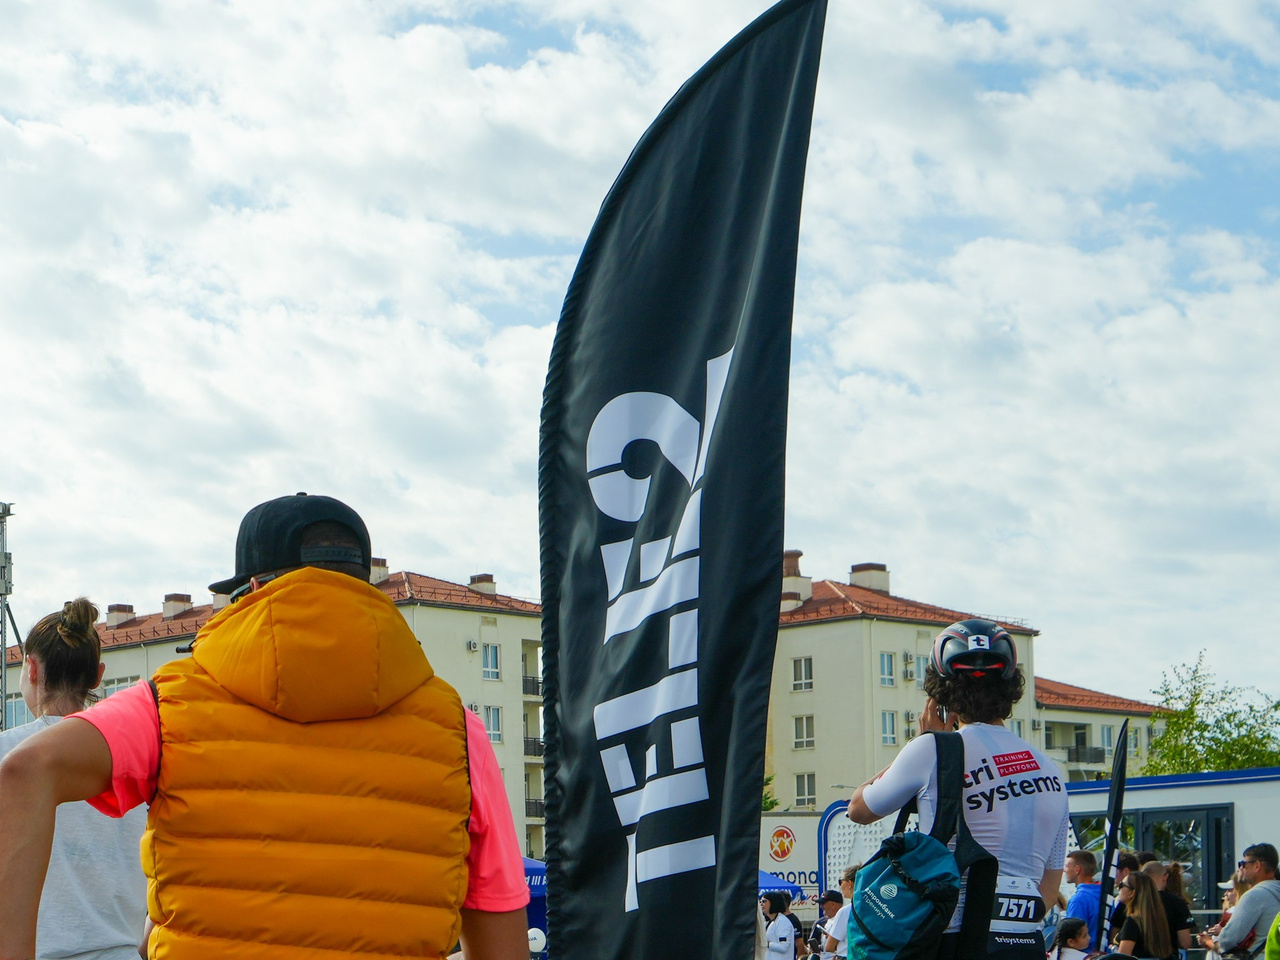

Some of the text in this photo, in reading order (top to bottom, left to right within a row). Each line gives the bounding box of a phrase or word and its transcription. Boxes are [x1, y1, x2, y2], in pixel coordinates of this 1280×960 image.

[995, 752, 1029, 764] TRAINING
[1000, 763, 1037, 774] PLATFORM
[966, 776, 1061, 813] systems
[998, 897, 1036, 919] 7571
